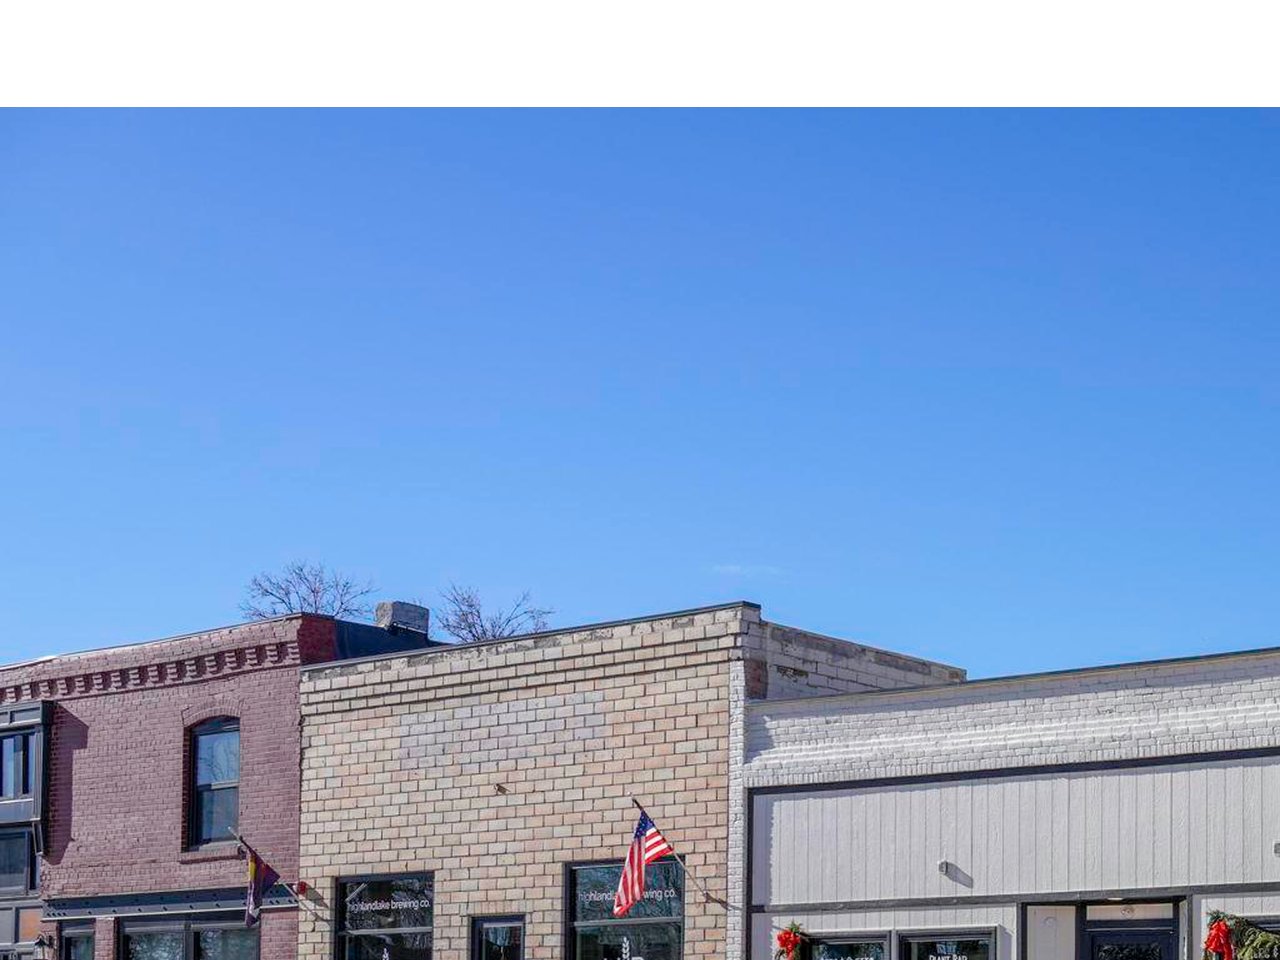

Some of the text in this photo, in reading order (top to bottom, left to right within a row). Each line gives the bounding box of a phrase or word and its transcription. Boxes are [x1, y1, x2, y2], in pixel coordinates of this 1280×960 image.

[643, 888, 662, 901] wing
[664, 888, 677, 898] co.
[391, 899, 419, 910] brewing
[420, 900, 431, 908] co.
